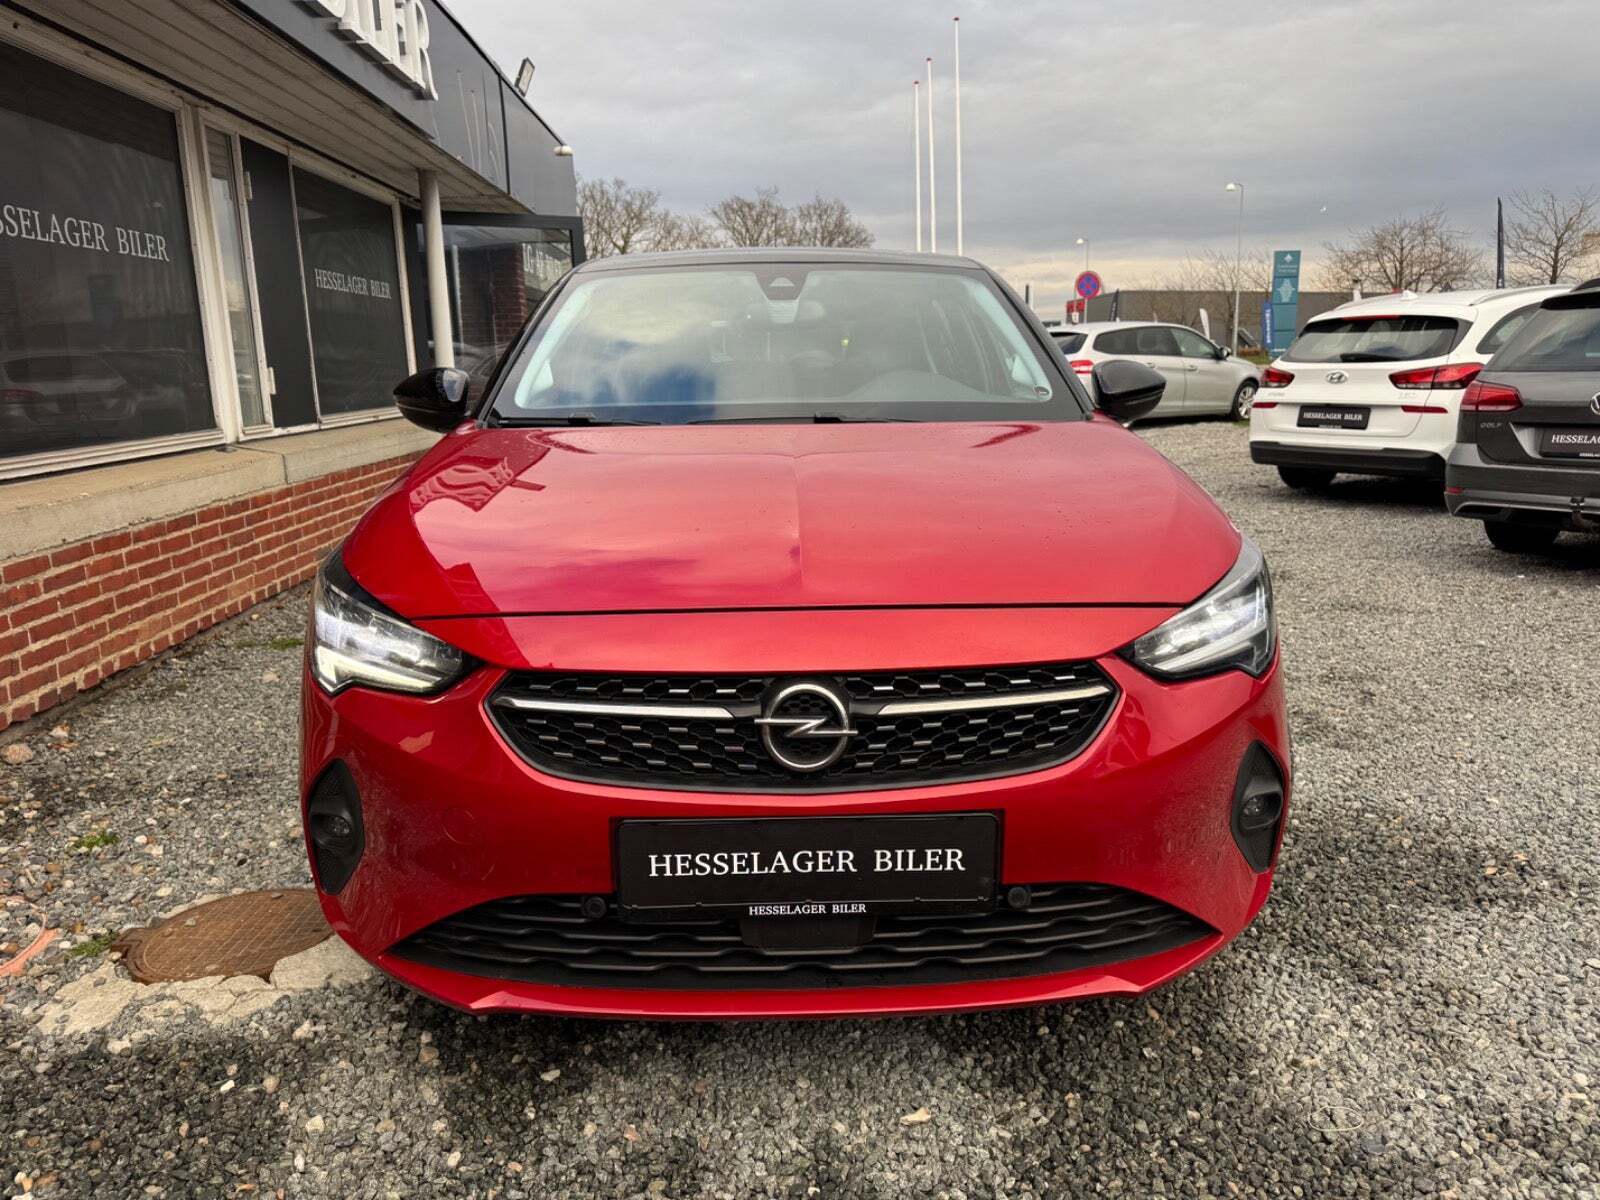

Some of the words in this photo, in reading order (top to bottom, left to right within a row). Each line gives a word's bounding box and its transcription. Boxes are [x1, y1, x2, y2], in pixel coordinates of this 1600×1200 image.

[310, 0, 438, 101] LER
[0, 204, 109, 252] SELAGER
[116, 227, 170, 262] BILER
[314, 268, 369, 296] HESSELAGER
[370, 279, 392, 299] BILER
[649, 850, 858, 877] HESSELAGER
[873, 848, 966, 872] BILER
[749, 904, 826, 916] HESSELAGER
[832, 903, 866, 914] BILER
